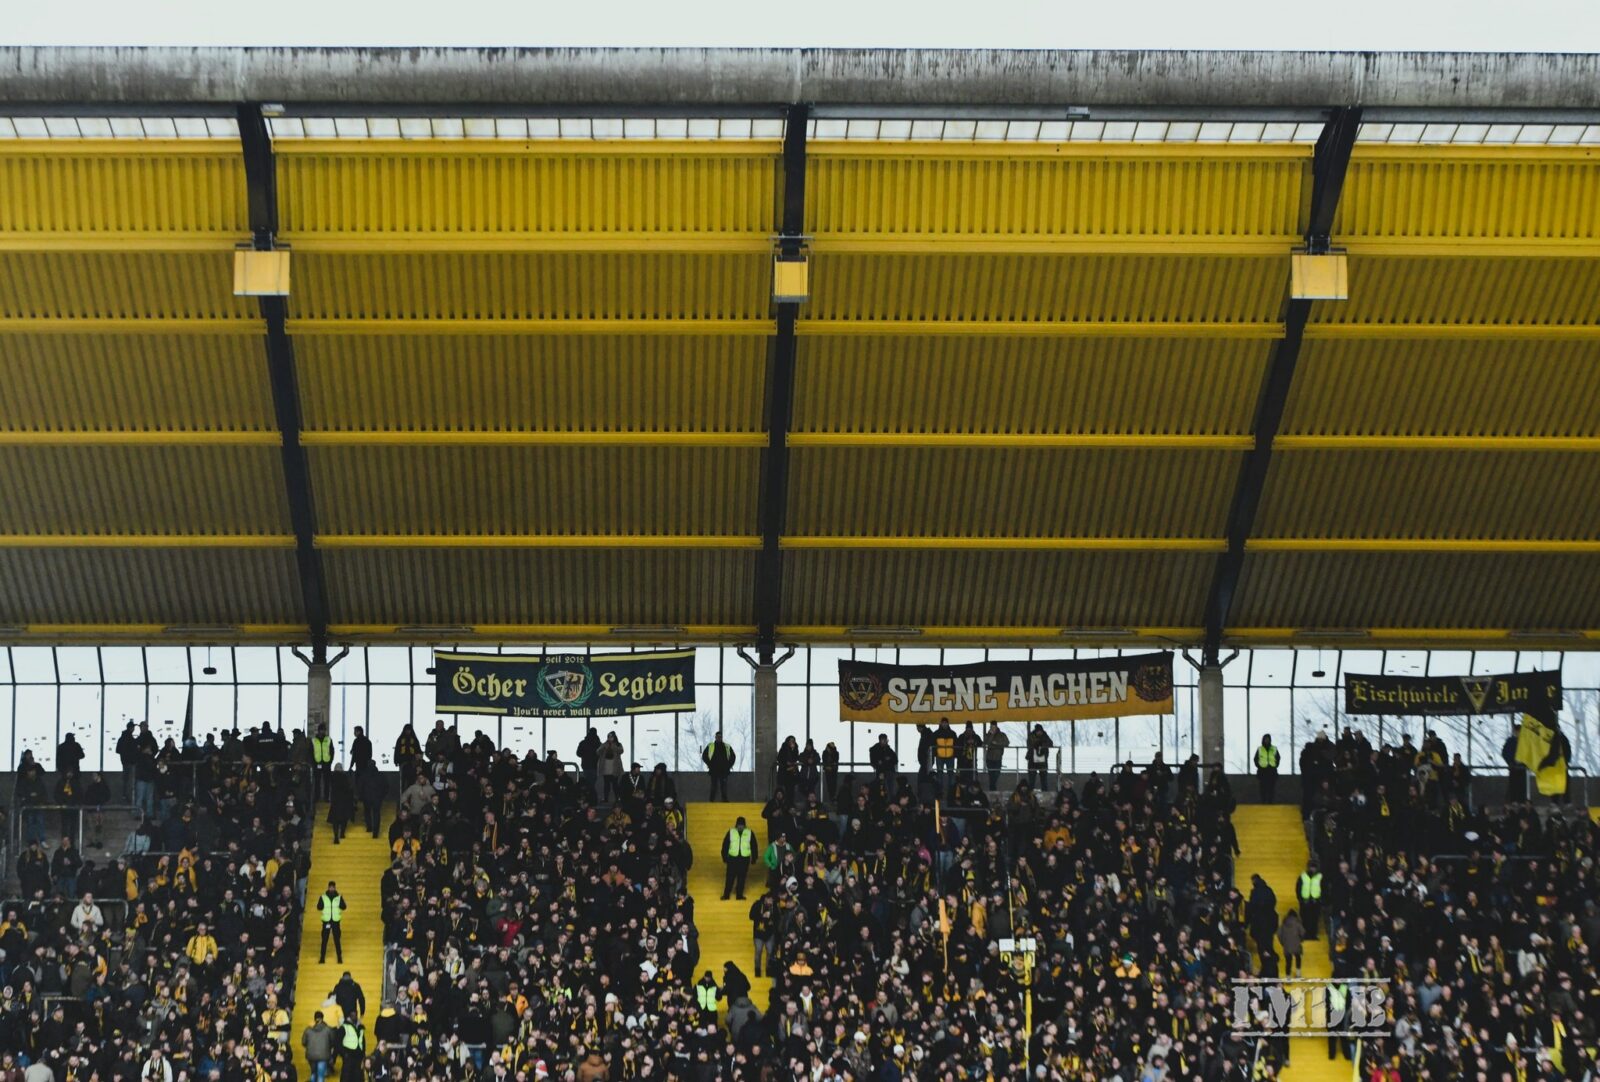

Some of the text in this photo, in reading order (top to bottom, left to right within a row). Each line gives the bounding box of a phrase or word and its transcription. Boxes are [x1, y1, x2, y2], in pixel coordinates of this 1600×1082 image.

[565, 656, 584, 664] 2012
[452, 666, 684, 701] Öcher Legion
[888, 670, 1129, 713] SZENE AACHEN
[513, 706, 618, 717] You'll never walk alone
